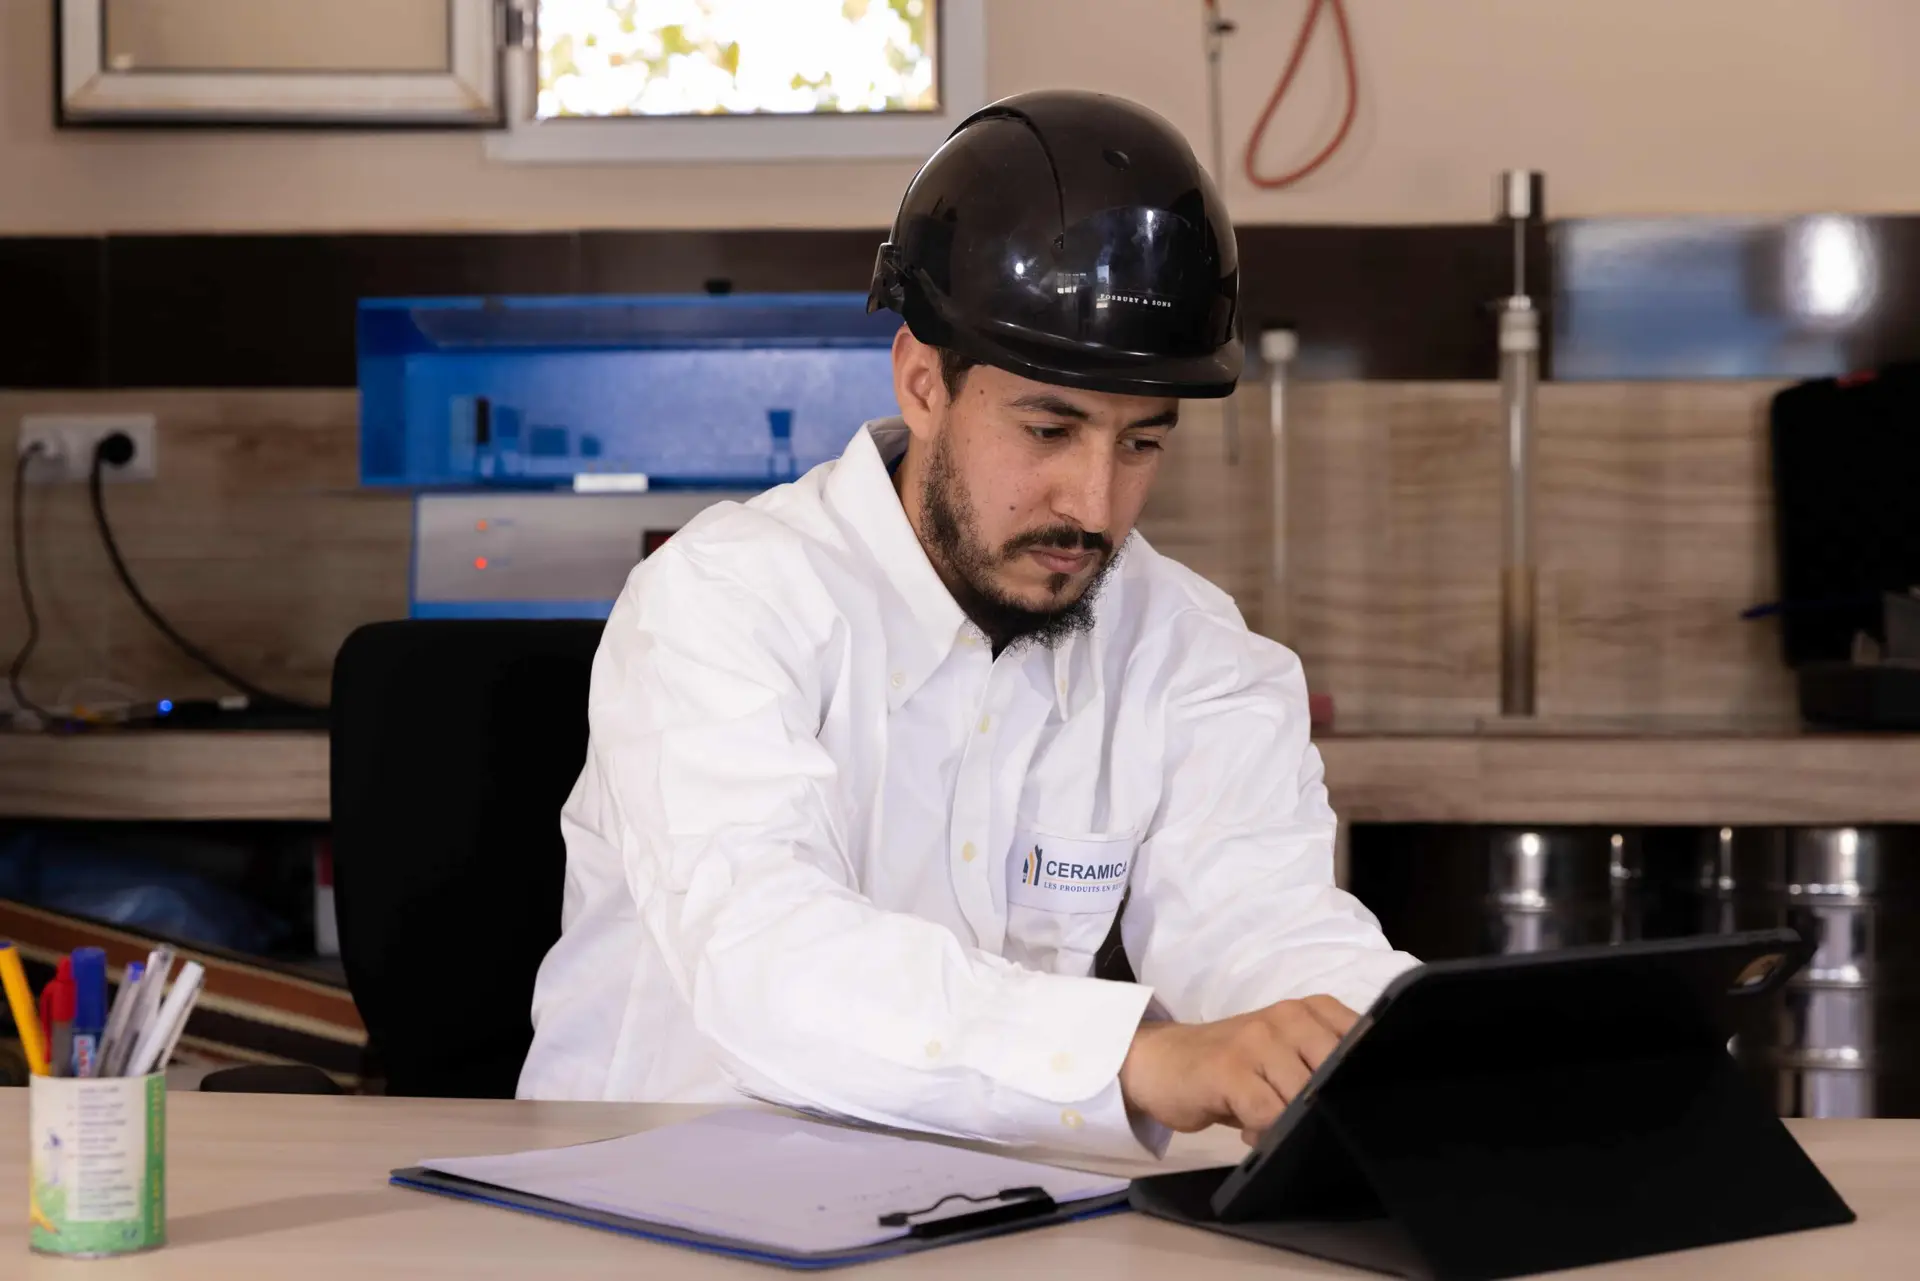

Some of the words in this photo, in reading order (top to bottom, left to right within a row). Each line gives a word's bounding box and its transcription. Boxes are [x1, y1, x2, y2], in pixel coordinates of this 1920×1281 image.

[1046, 860, 1127, 880] CERAMICA
[1044, 881, 1057, 890] LES
[1060, 884, 1100, 892] PRODUITS
